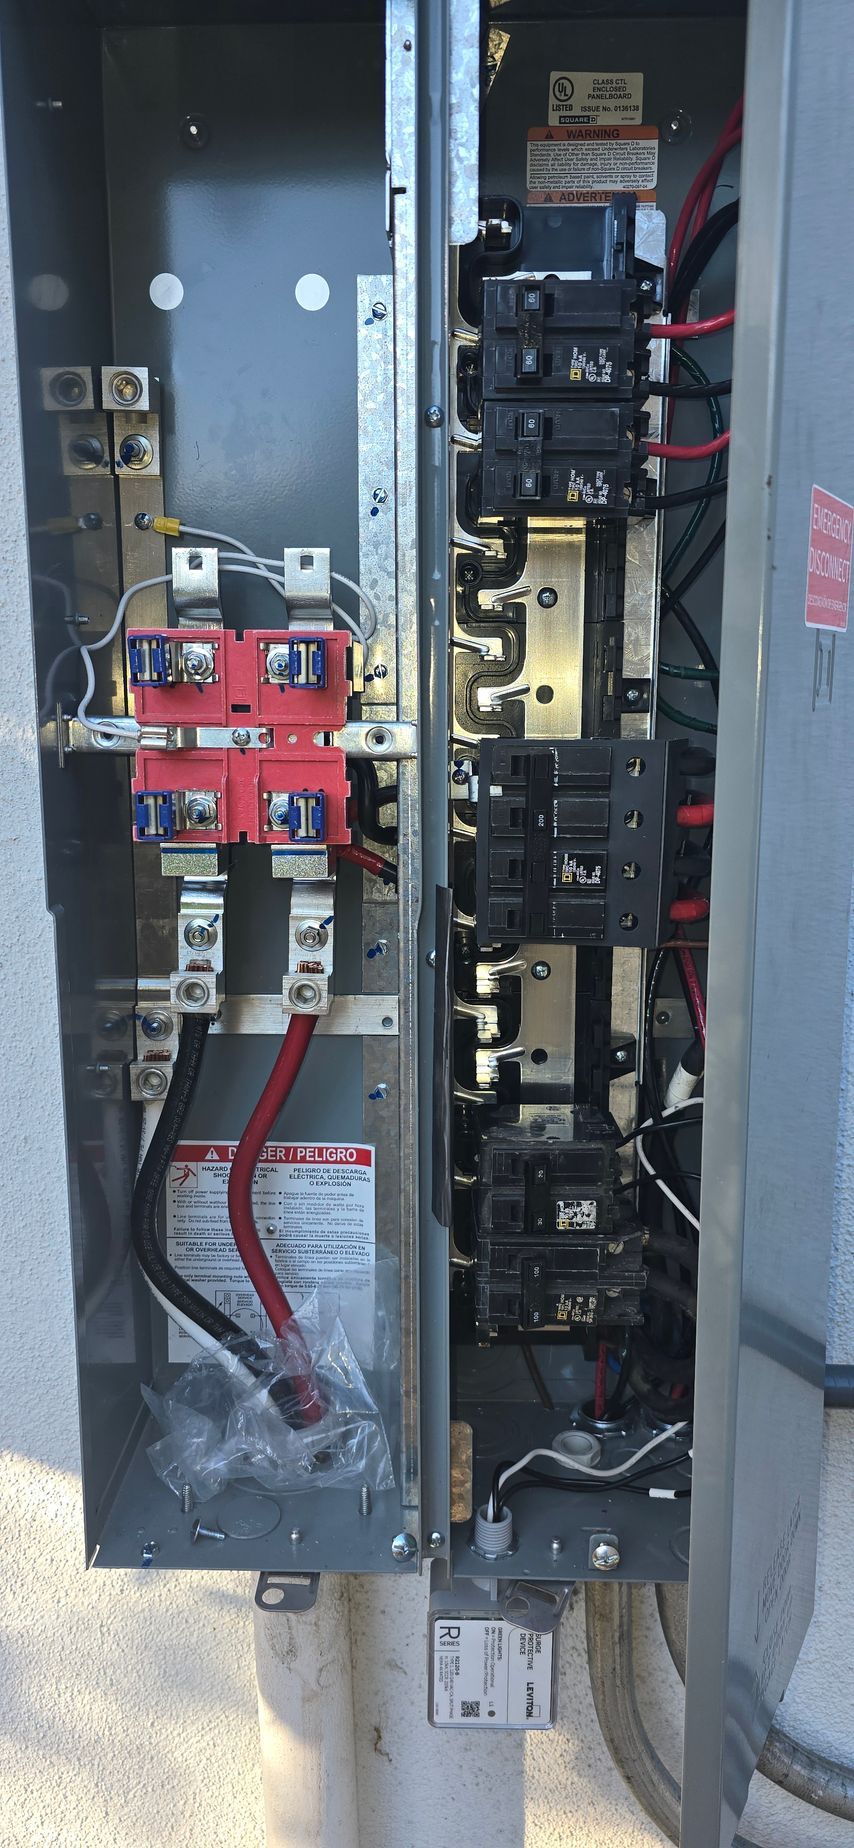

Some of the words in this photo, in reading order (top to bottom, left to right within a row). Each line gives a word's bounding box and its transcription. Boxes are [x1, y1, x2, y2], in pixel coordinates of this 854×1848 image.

[566, 129, 619, 139] WARNING
[528, 293, 535, 303] 60
[526, 355, 532, 365] 60
[528, 419, 535, 429] 60
[526, 478, 532, 488] 60
[813, 503, 852, 544] EMERGENCY
[809, 546, 850, 583] DISCONNECT
[228, 1148, 286, 1160] DGER
[297, 1148, 356, 1161] PELIGRO
[439, 1626, 460, 1639] R
[526, 1682, 534, 1718] LEVITON
